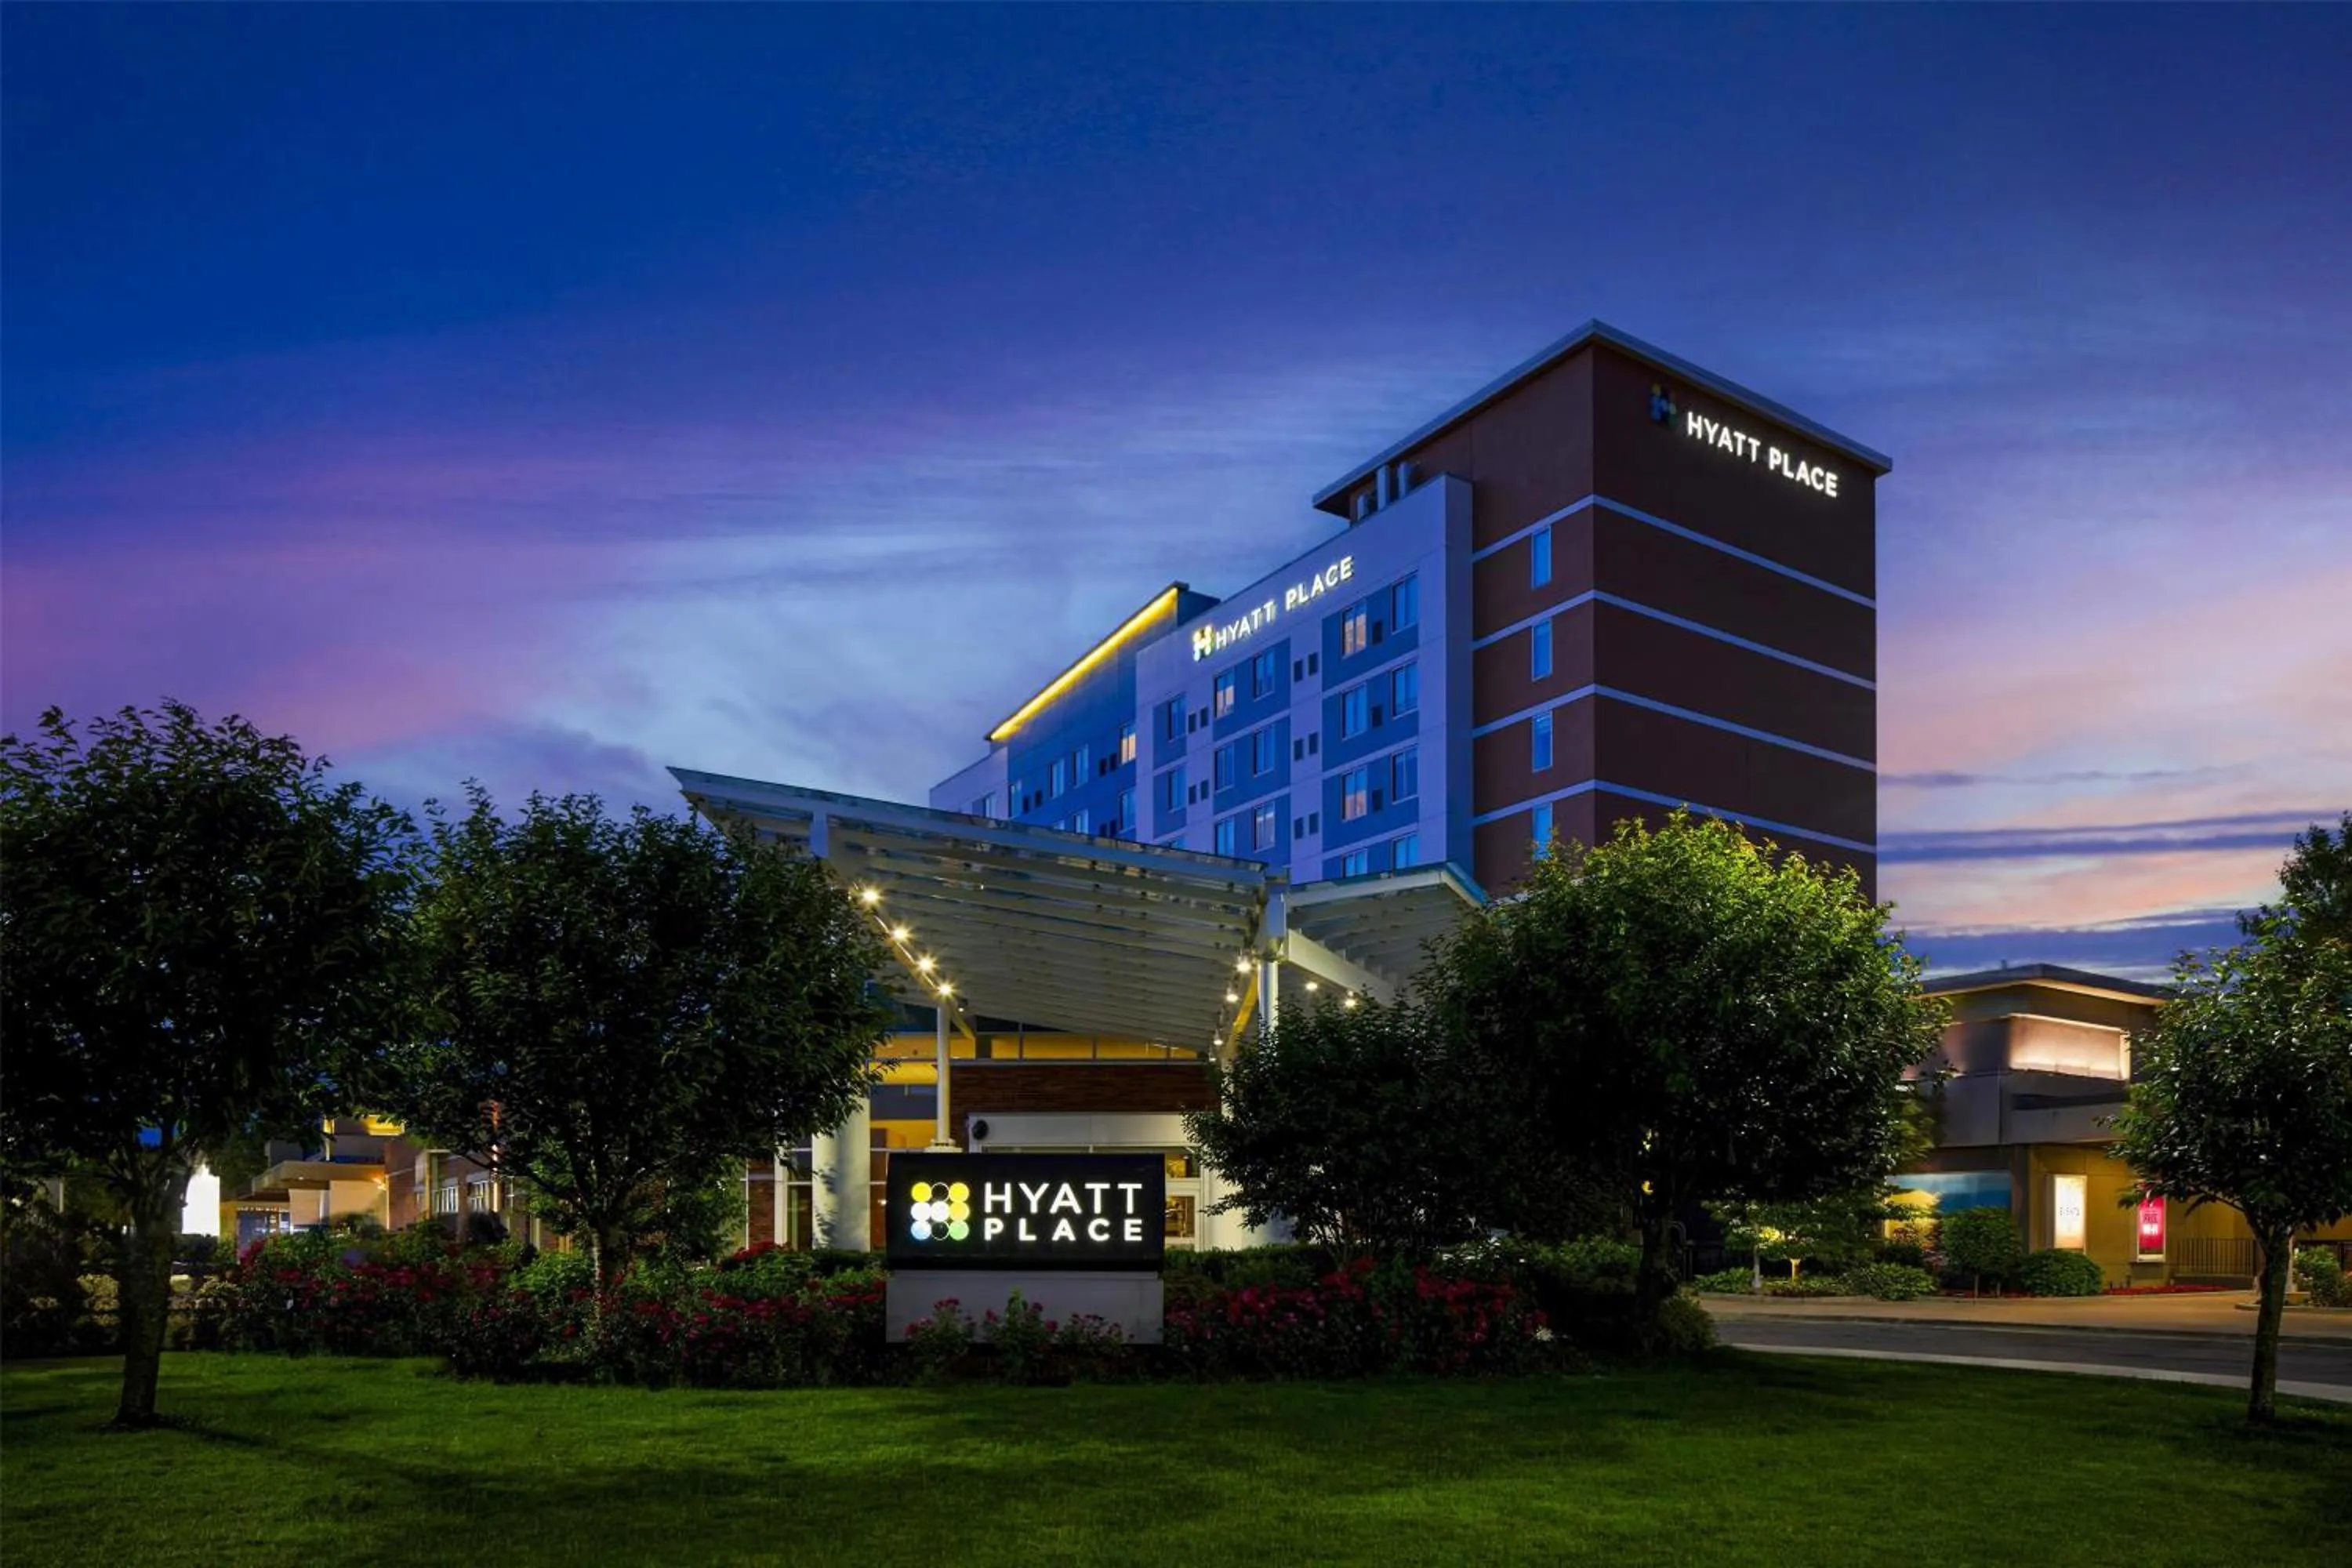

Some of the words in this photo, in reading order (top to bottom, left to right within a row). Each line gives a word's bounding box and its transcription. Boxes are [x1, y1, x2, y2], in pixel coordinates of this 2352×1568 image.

[1686, 412, 1761, 463] HYATT
[1769, 447, 1838, 498] PLACE
[1216, 599, 1275, 650] HYATT
[1286, 556, 1352, 611] PLACE
[984, 1181, 1142, 1214] HYATT
[984, 1218, 1142, 1242] PLACE
